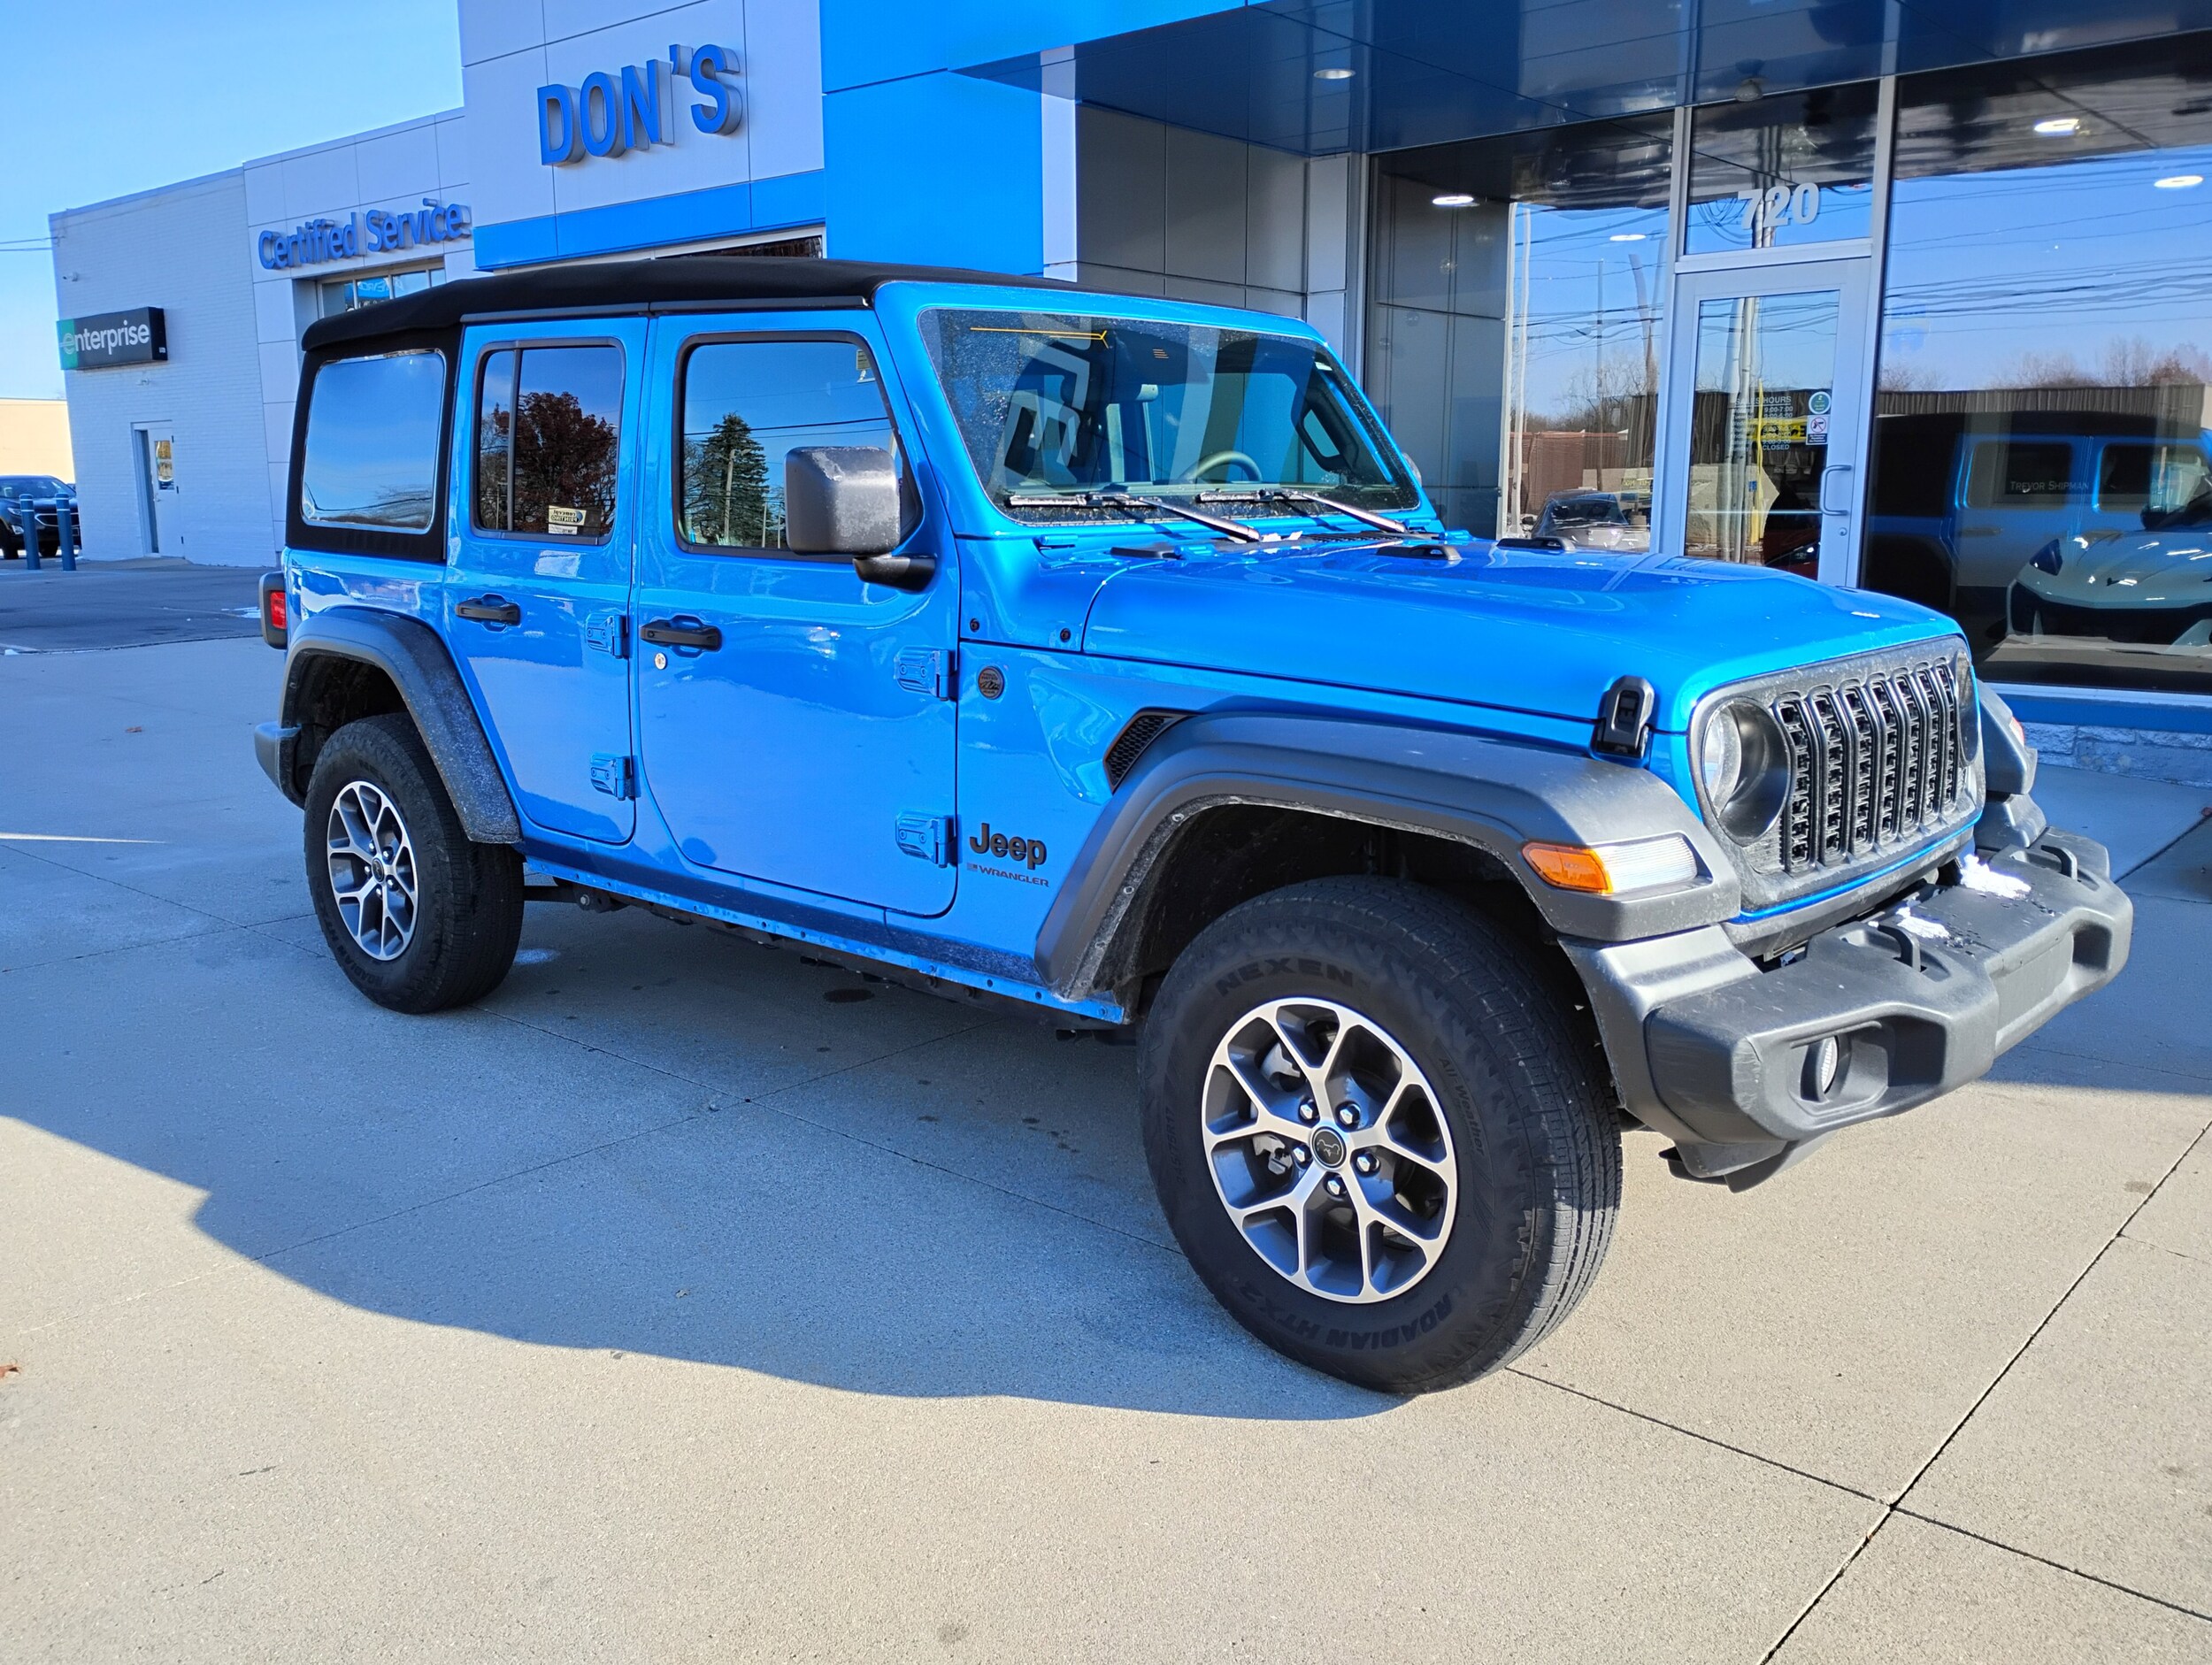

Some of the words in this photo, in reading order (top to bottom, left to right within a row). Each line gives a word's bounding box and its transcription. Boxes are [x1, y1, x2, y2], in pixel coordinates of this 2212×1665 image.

[537, 43, 741, 165] DON'S
[1738, 182, 1820, 230] 720
[258, 211, 360, 270] Certified
[365, 197, 467, 252] Service
[60, 319, 150, 355] enterprise
[1763, 395, 1792, 404] HOURS
[2010, 481, 2046, 490] TREVOR
[2048, 480, 2089, 490] SHIPMAN
[970, 823, 1048, 871] Jeep
[979, 865, 1049, 887] WRANGLER
[1215, 957, 1354, 997] NEXEN
[1439, 1058, 1486, 1156] All-Weather
[1326, 1293, 1454, 1350] ROADIAN
